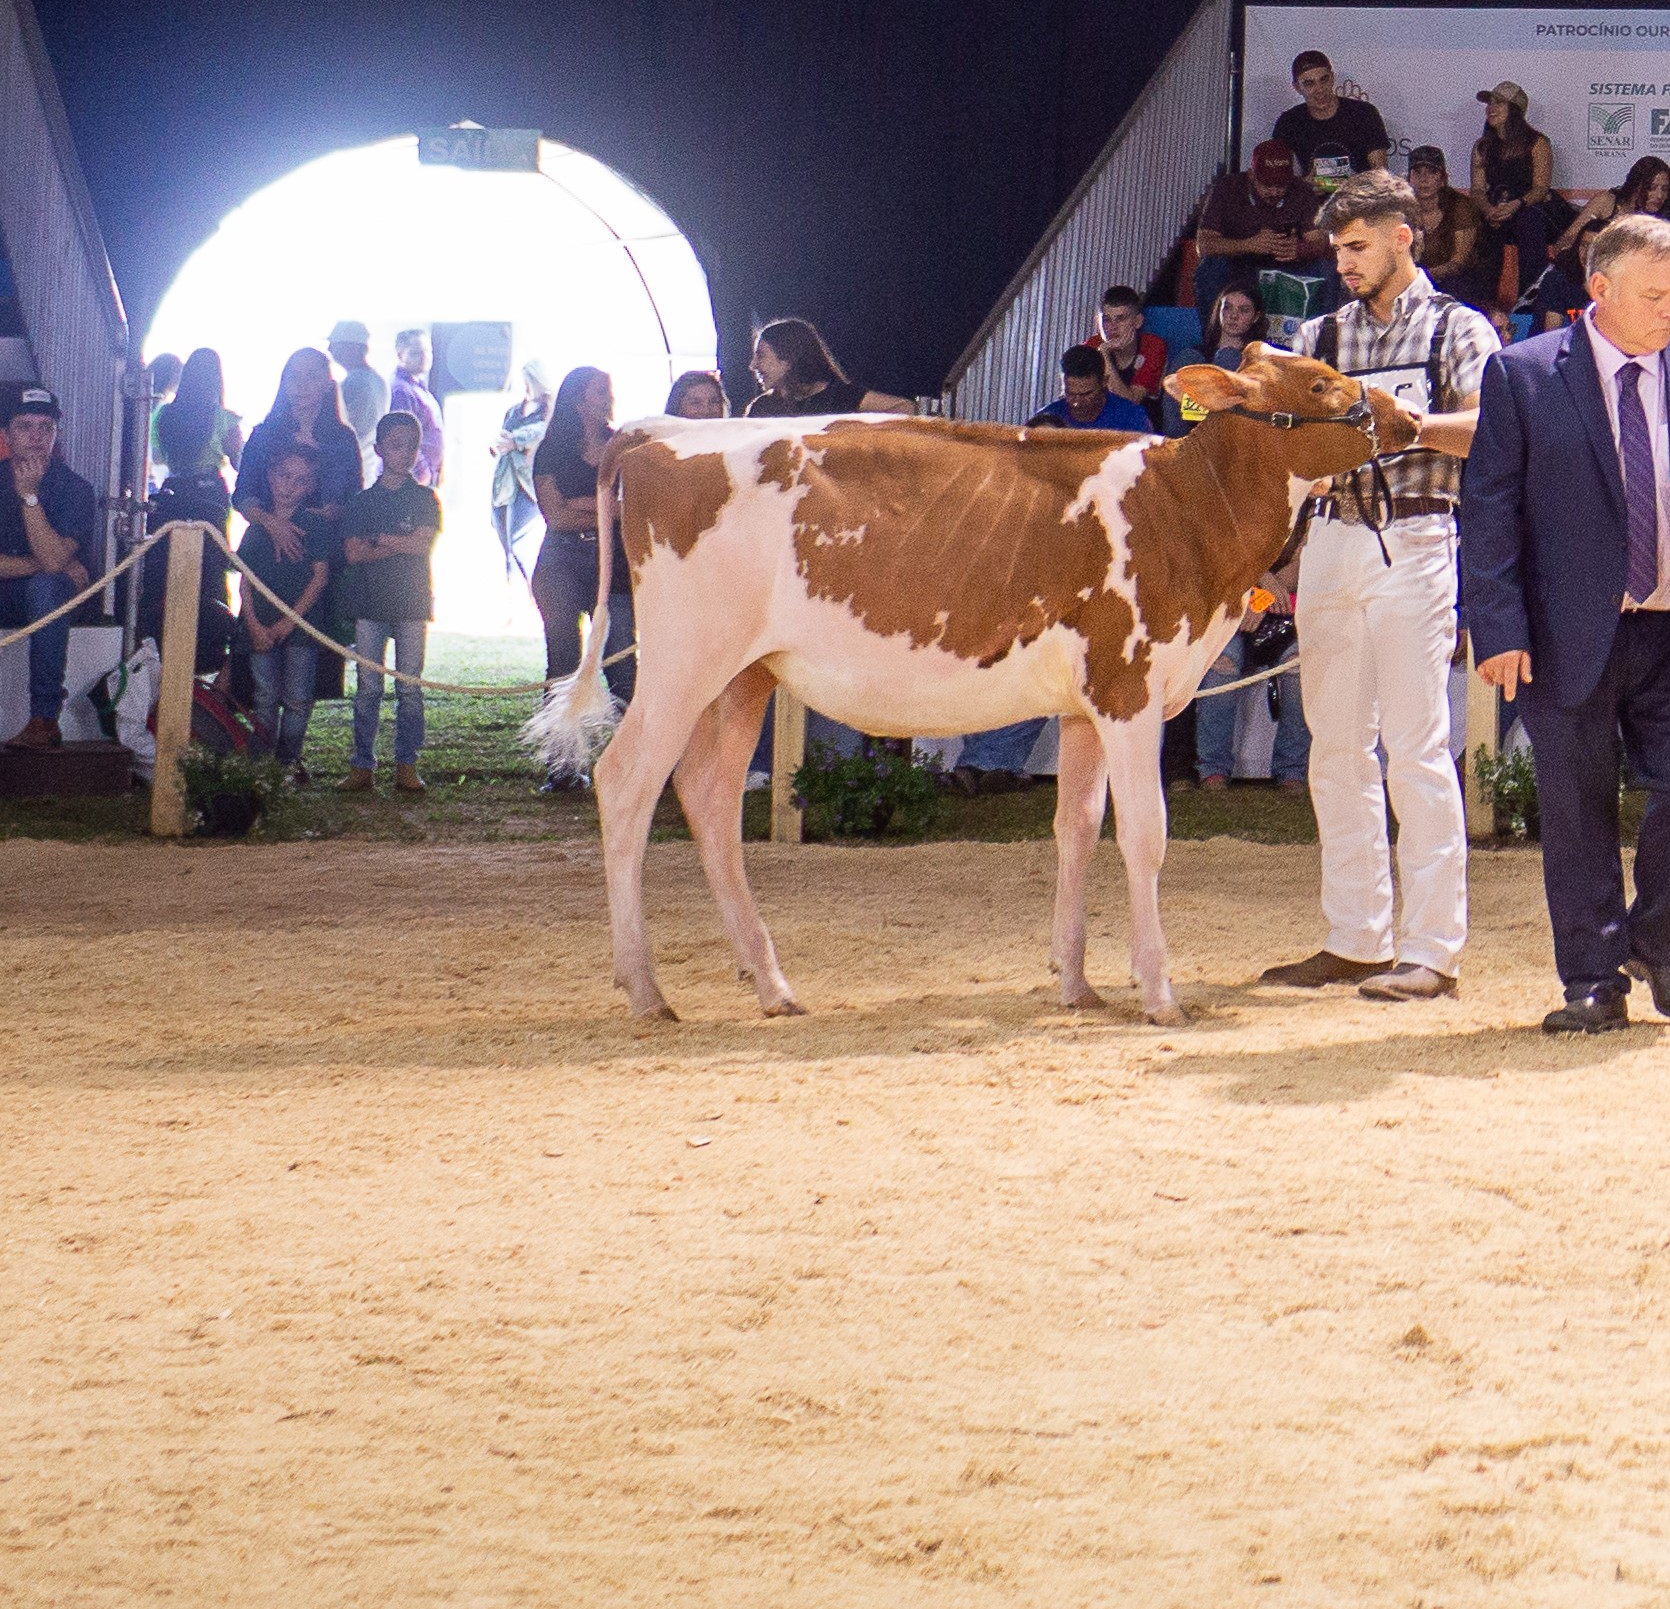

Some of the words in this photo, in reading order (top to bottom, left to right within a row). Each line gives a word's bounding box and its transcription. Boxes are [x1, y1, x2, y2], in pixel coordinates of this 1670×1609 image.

[1535, 21, 1632, 37] PATROCÍNIO
[1589, 82, 1657, 96] SISTEMA
[1590, 135, 1631, 147] SENAR
